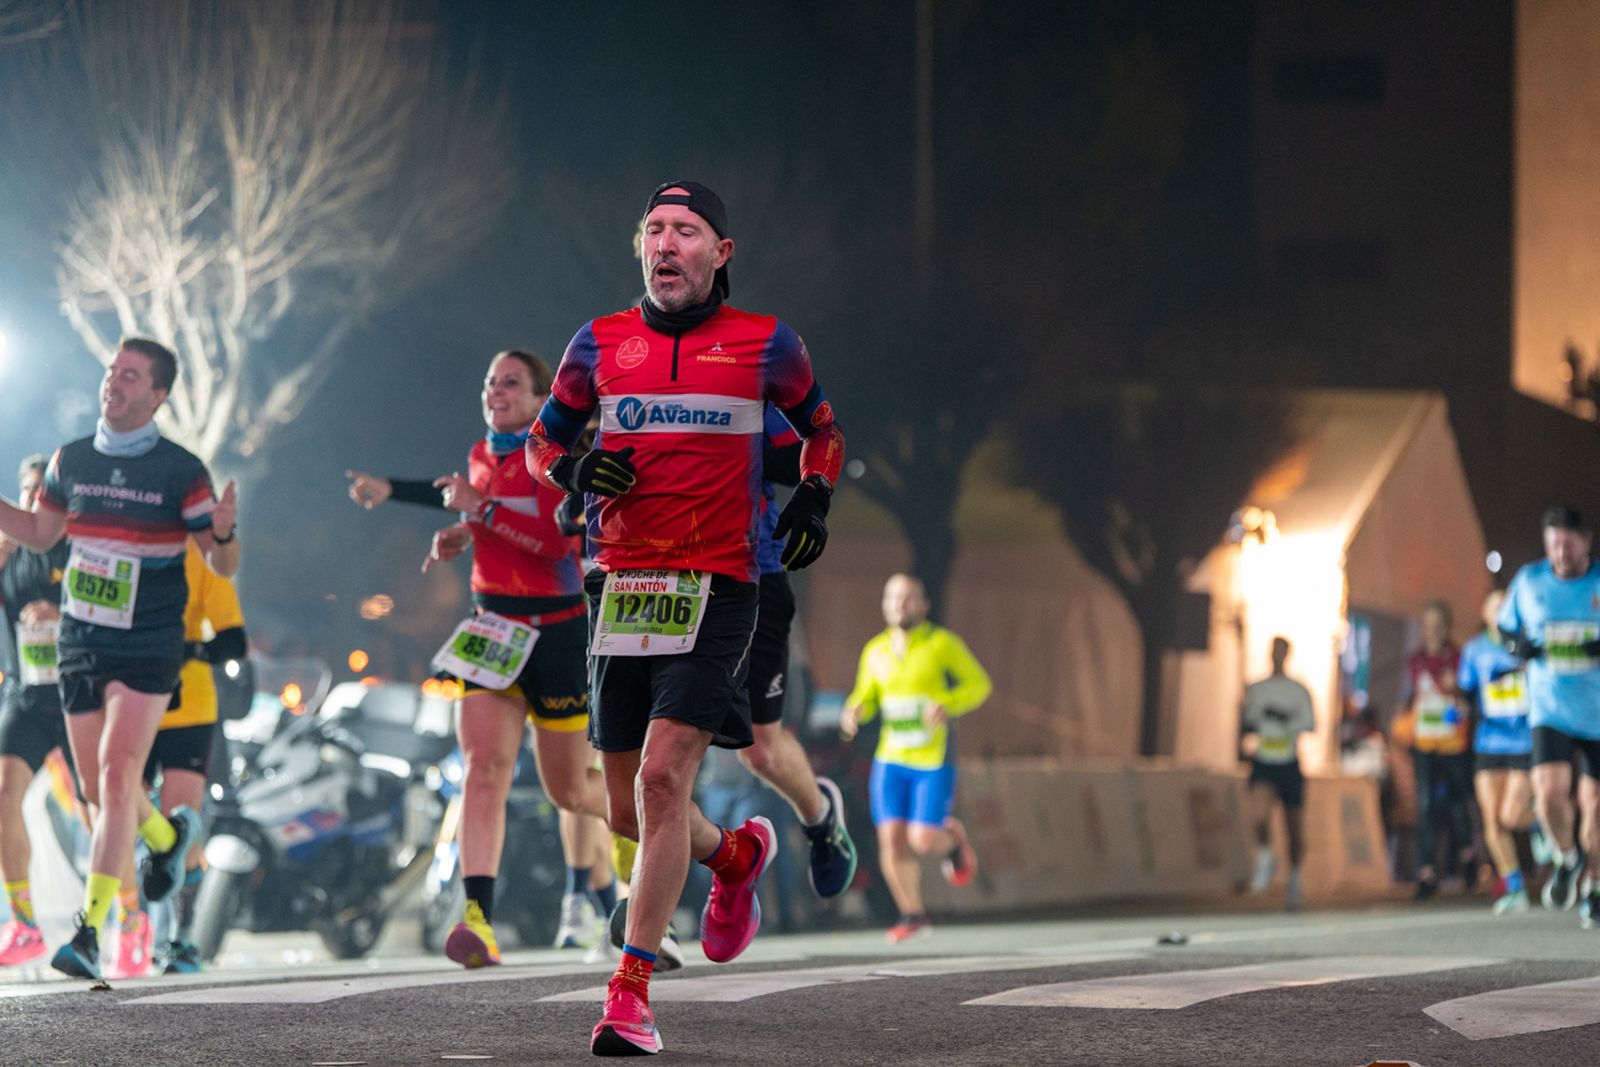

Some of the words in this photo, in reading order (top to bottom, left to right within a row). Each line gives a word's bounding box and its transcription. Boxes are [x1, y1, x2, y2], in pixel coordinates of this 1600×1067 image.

[696, 355, 737, 364] FRANCISCO
[648, 405, 733, 426] Avanza
[76, 571, 118, 602] 8575
[614, 582, 632, 592] SAN
[633, 579, 668, 593] ANTÓN
[614, 595, 692, 625] 12406
